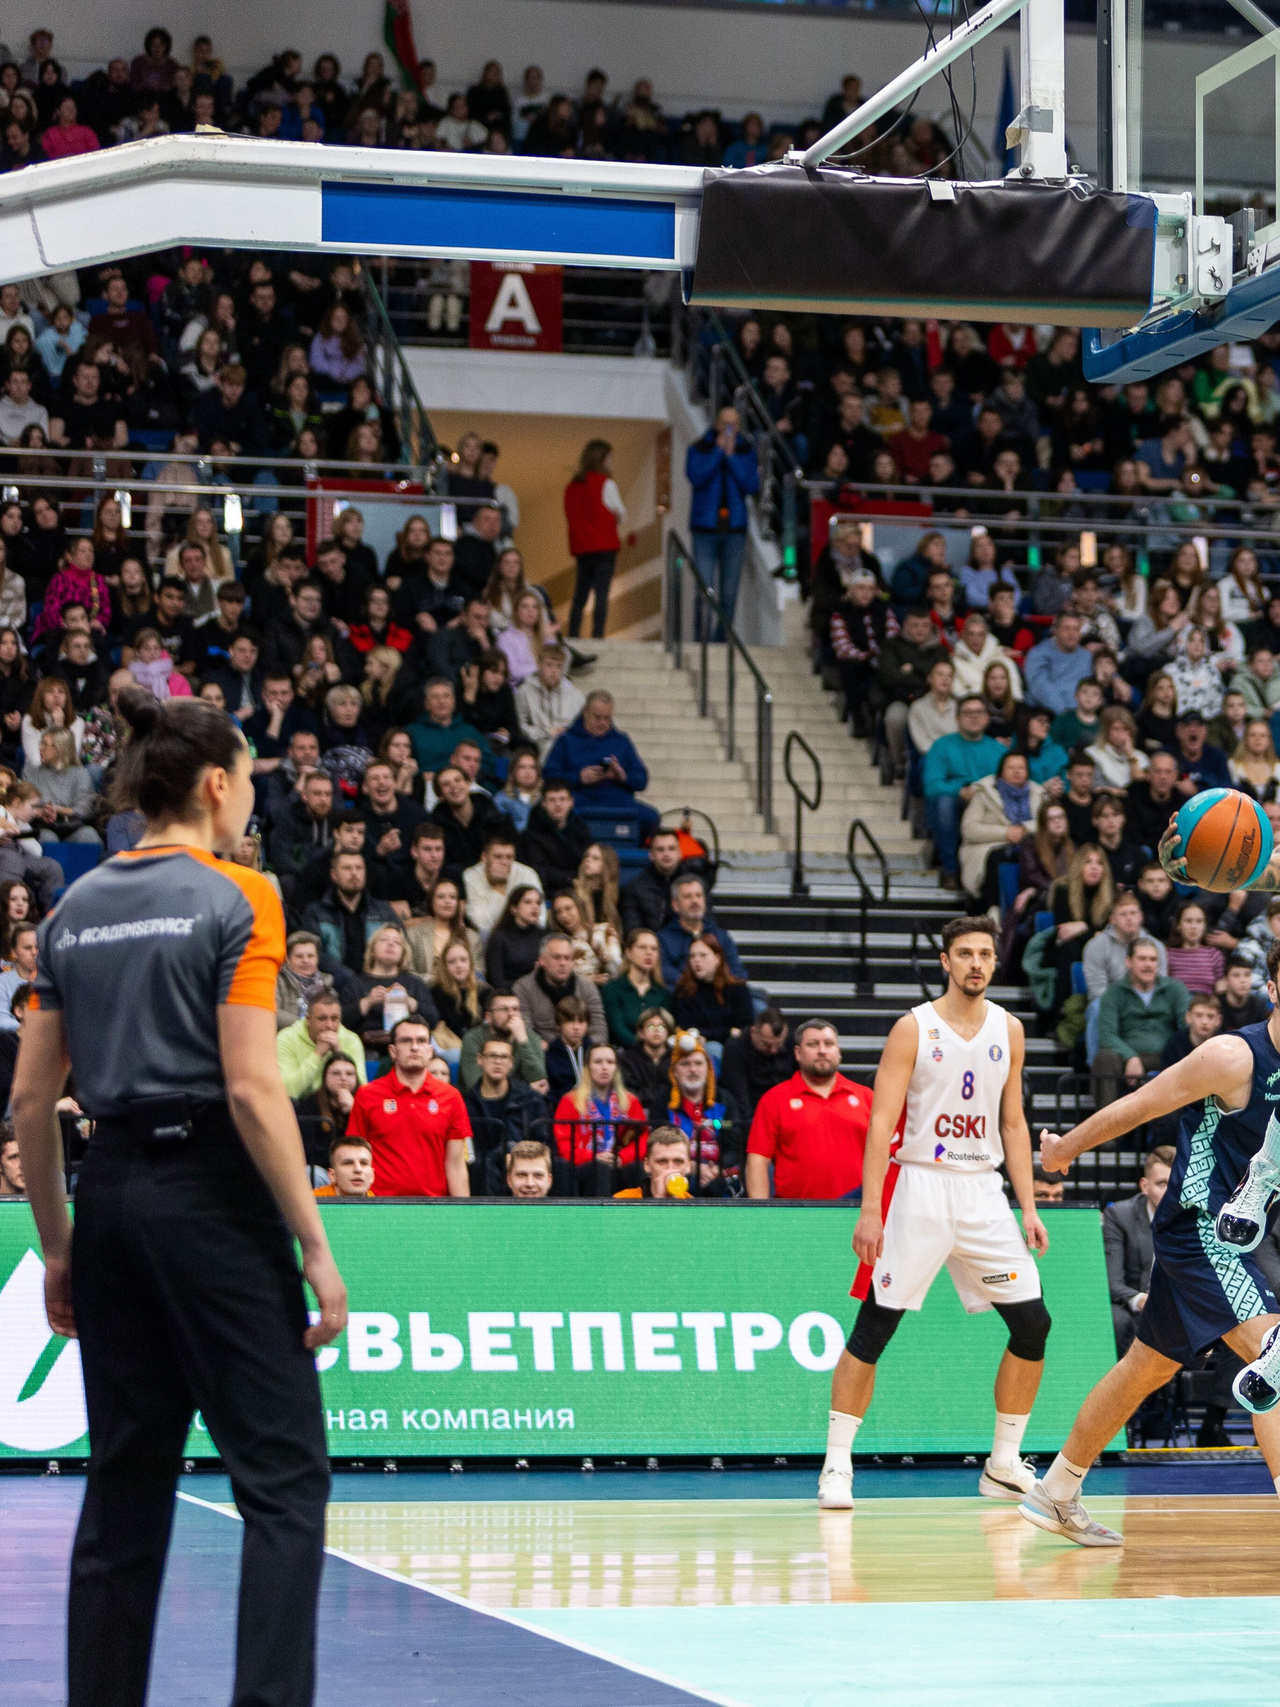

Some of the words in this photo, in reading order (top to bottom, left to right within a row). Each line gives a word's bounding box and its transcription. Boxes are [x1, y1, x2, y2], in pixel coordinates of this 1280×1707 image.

[961, 1070, 974, 1100] 8
[947, 1151, 991, 1161] Rosteleco
[309, 1311, 847, 1372] ВЬЕТПЕТРО
[402, 1407, 576, 1431] компания
